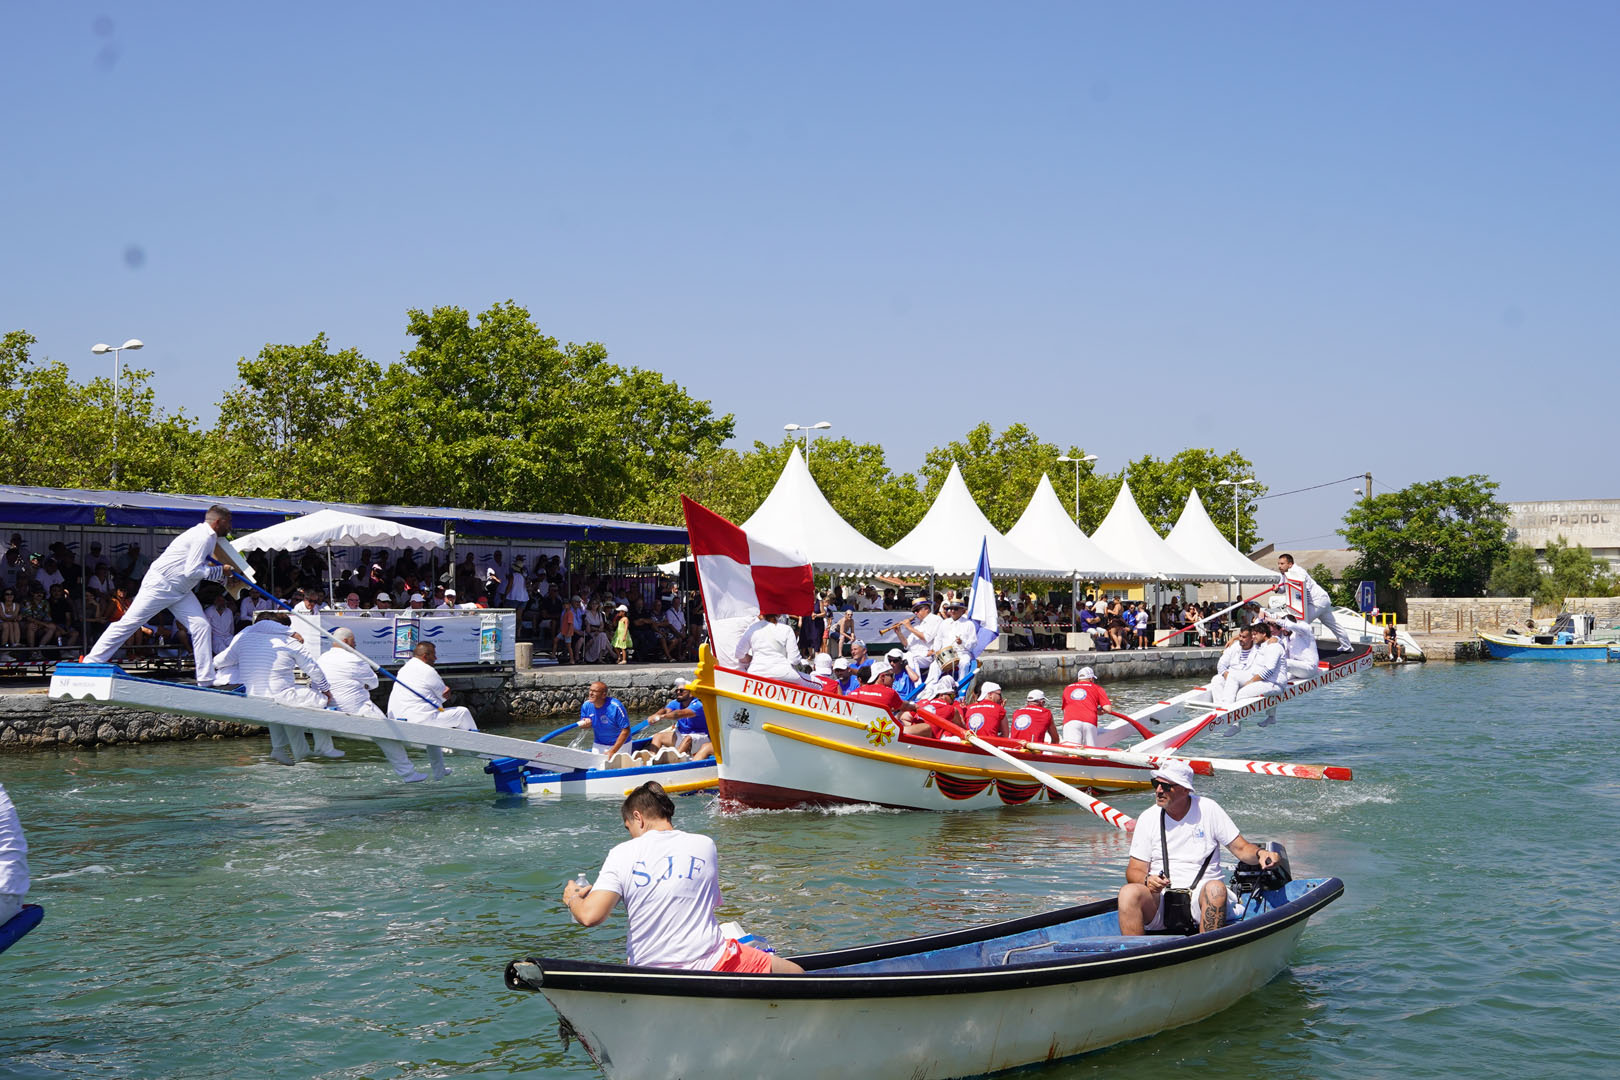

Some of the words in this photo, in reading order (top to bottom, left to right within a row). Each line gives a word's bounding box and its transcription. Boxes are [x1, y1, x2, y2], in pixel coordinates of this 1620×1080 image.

[742, 679, 855, 717] FRONTIGNAN
[1226, 687, 1295, 724] FRONTIGNAN
[1298, 679, 1319, 696] SON
[1320, 662, 1359, 687] MUSCAT
